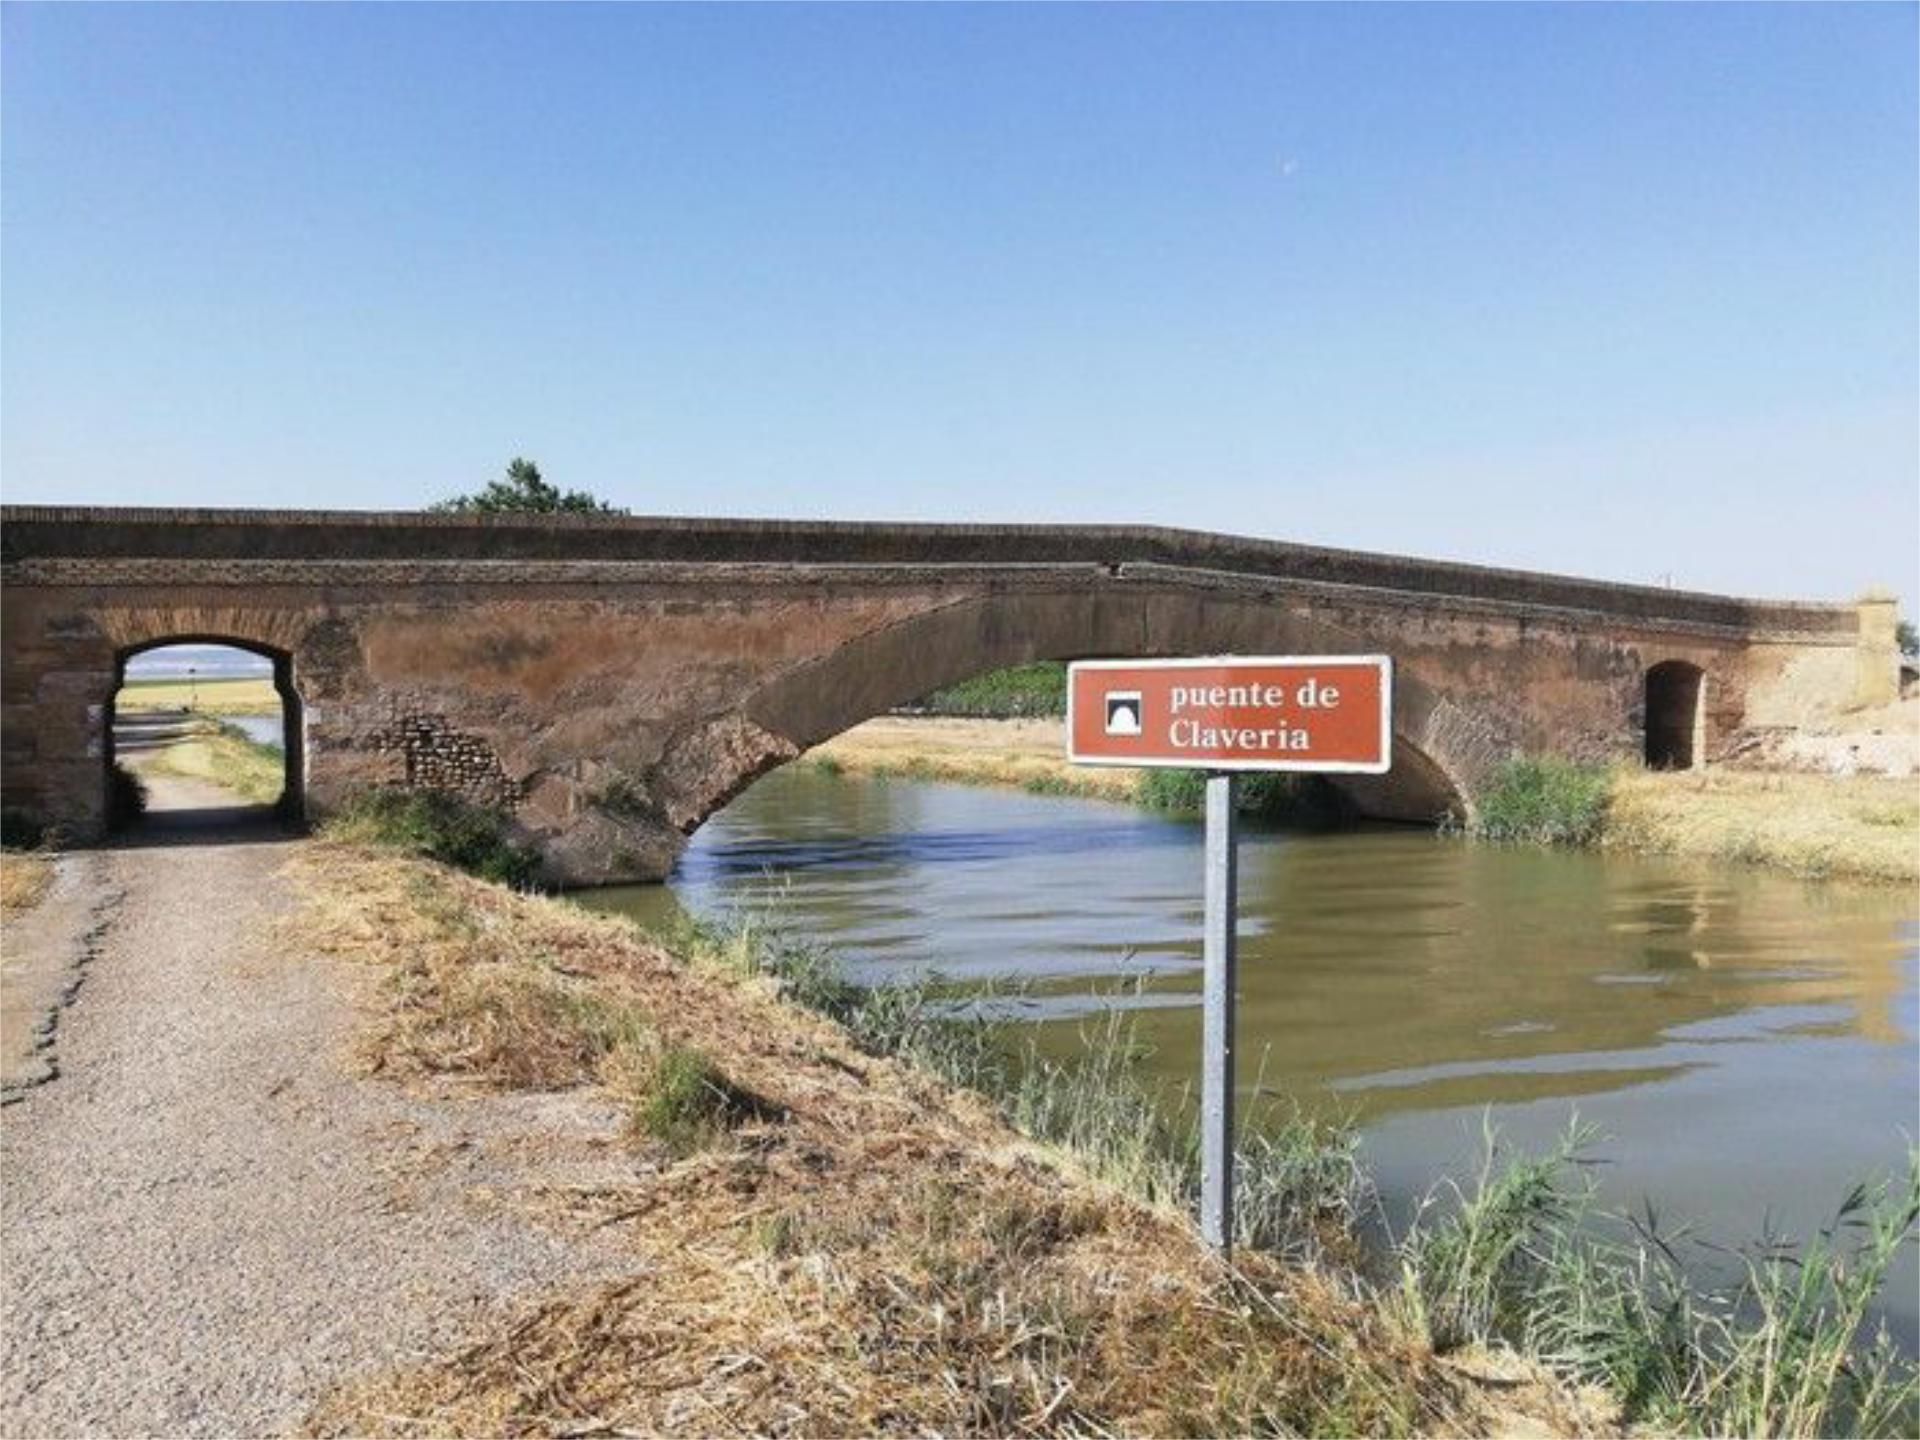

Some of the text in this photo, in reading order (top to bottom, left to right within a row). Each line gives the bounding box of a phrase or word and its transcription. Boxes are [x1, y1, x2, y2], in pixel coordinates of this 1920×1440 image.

[1169, 678, 1340, 714] puente de
[1168, 718, 1310, 750] Claveria
